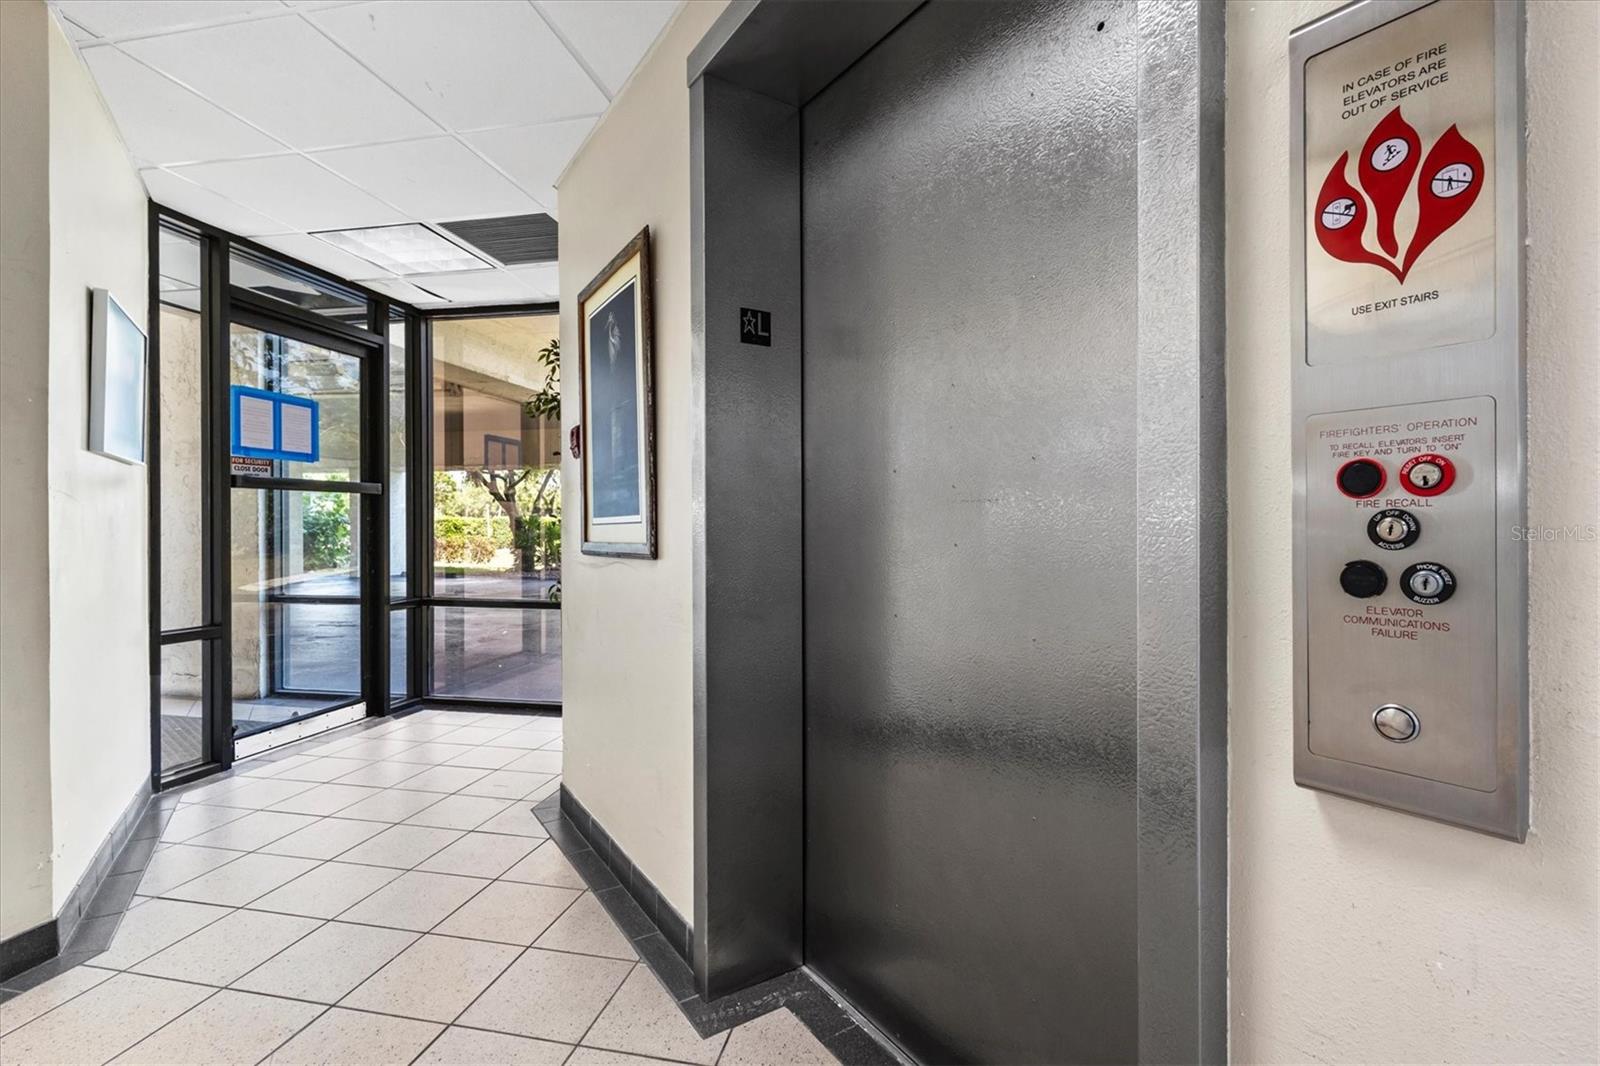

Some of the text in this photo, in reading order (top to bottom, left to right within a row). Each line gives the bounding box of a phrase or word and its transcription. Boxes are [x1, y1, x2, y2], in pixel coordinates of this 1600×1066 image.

[1342, 43, 1447, 93] IN CASE OF FIRE
[1343, 59, 1446, 106] ELEVATORS ARE
[1342, 72, 1449, 120] OUT OF SERVICE
[1352, 290, 1439, 316] USE EXIT STAIRS
[1407, 417, 1477, 431] OPERATION
[1378, 437, 1427, 447] ELEVATORS
[1432, 434, 1465, 443] INSERT
[1441, 443, 1461, 451] "ON"
[1402, 459, 1417, 475] RESET
[1356, 498, 1432, 508] FIRE RECALL
[1402, 514, 1416, 531] DOWN
[1378, 542, 1404, 550] ACCESS
[1439, 569, 1452, 585] RESET
[1366, 606, 1423, 617] ELEVATOR
[1343, 615, 1450, 632] COMMUNICATIONS
[1371, 628, 1418, 640] FAILURE
